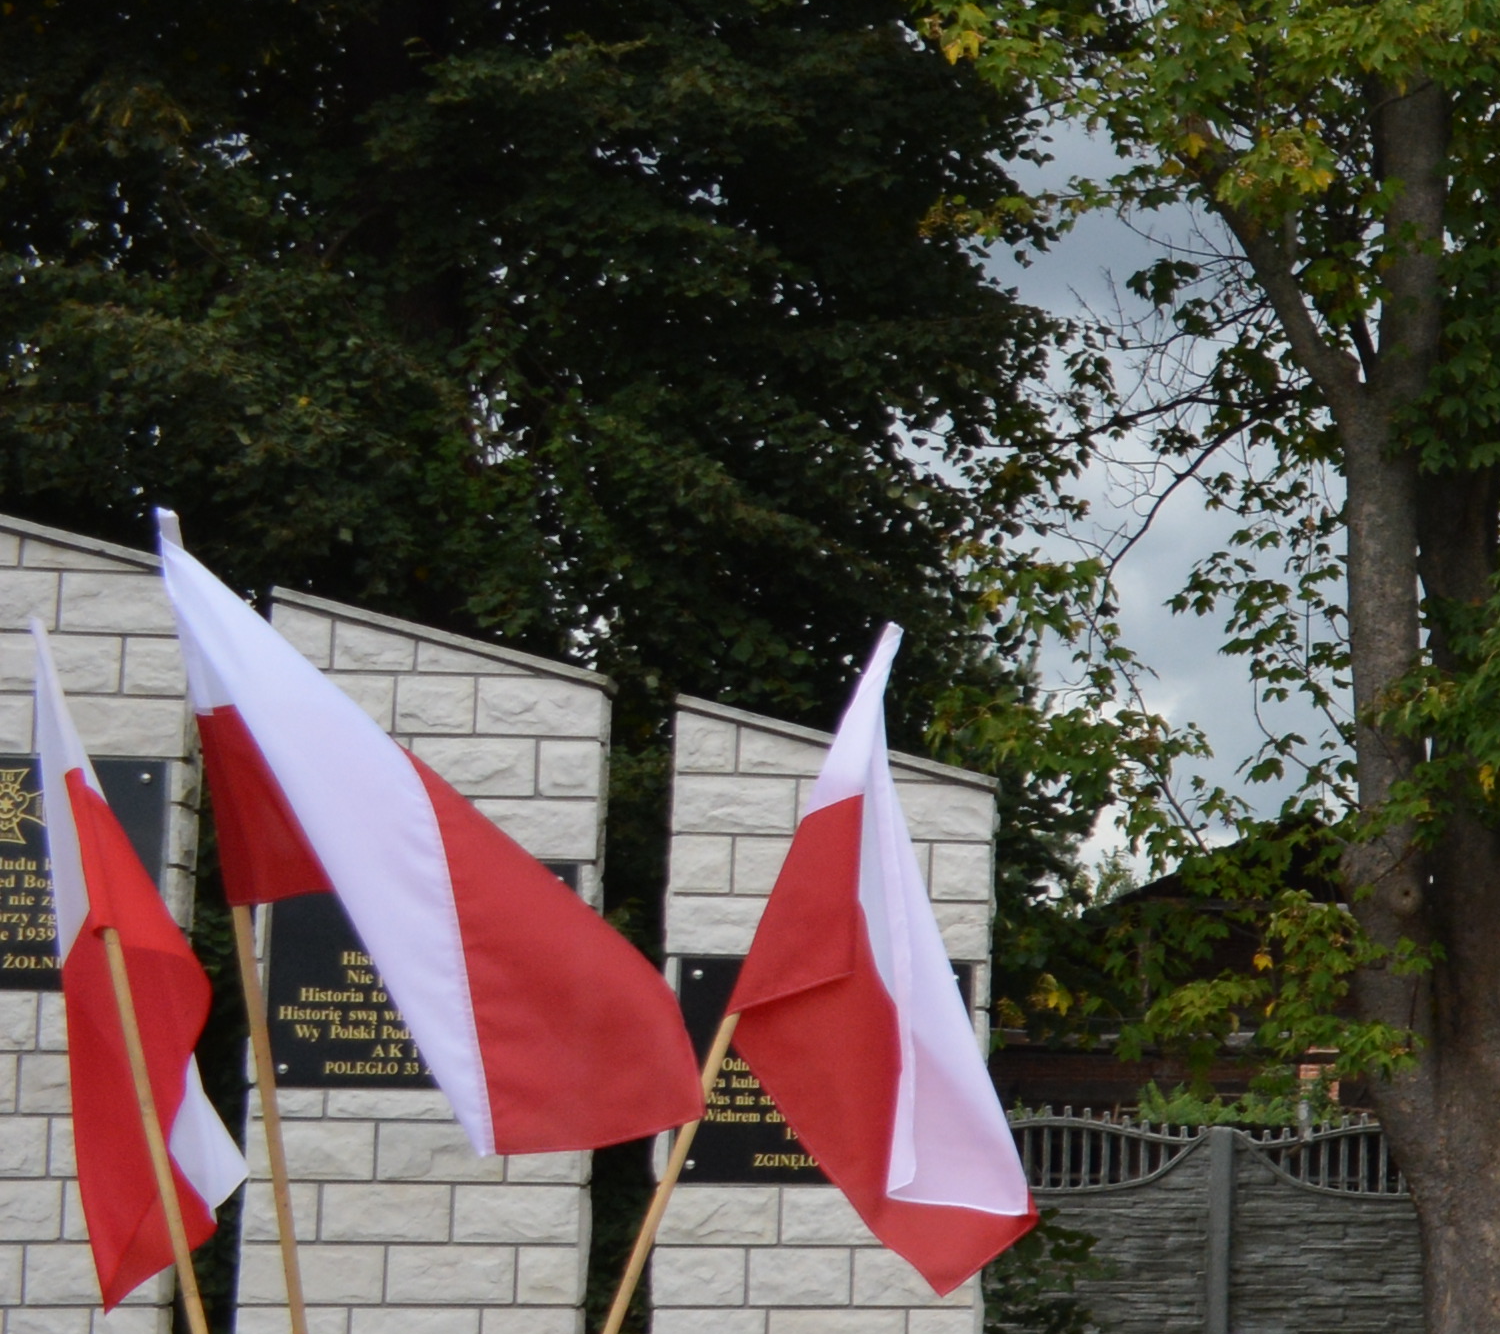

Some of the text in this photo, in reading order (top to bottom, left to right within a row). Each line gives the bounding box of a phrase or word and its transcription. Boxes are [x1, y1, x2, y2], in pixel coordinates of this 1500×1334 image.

[8, 892, 35, 906] nie
[17, 927, 57, 941] 1939
[347, 969, 374, 984] Nie
[300, 987, 387, 1003] Historia to
[278, 1005, 342, 1025] Historię
[349, 1010, 378, 1025] swą
[294, 1024, 321, 1043] Wy
[330, 1025, 376, 1040] Polski
[324, 1061, 398, 1075] POLEGŁO
[403, 1062, 419, 1075] 33
[735, 1092, 755, 1106] nie
